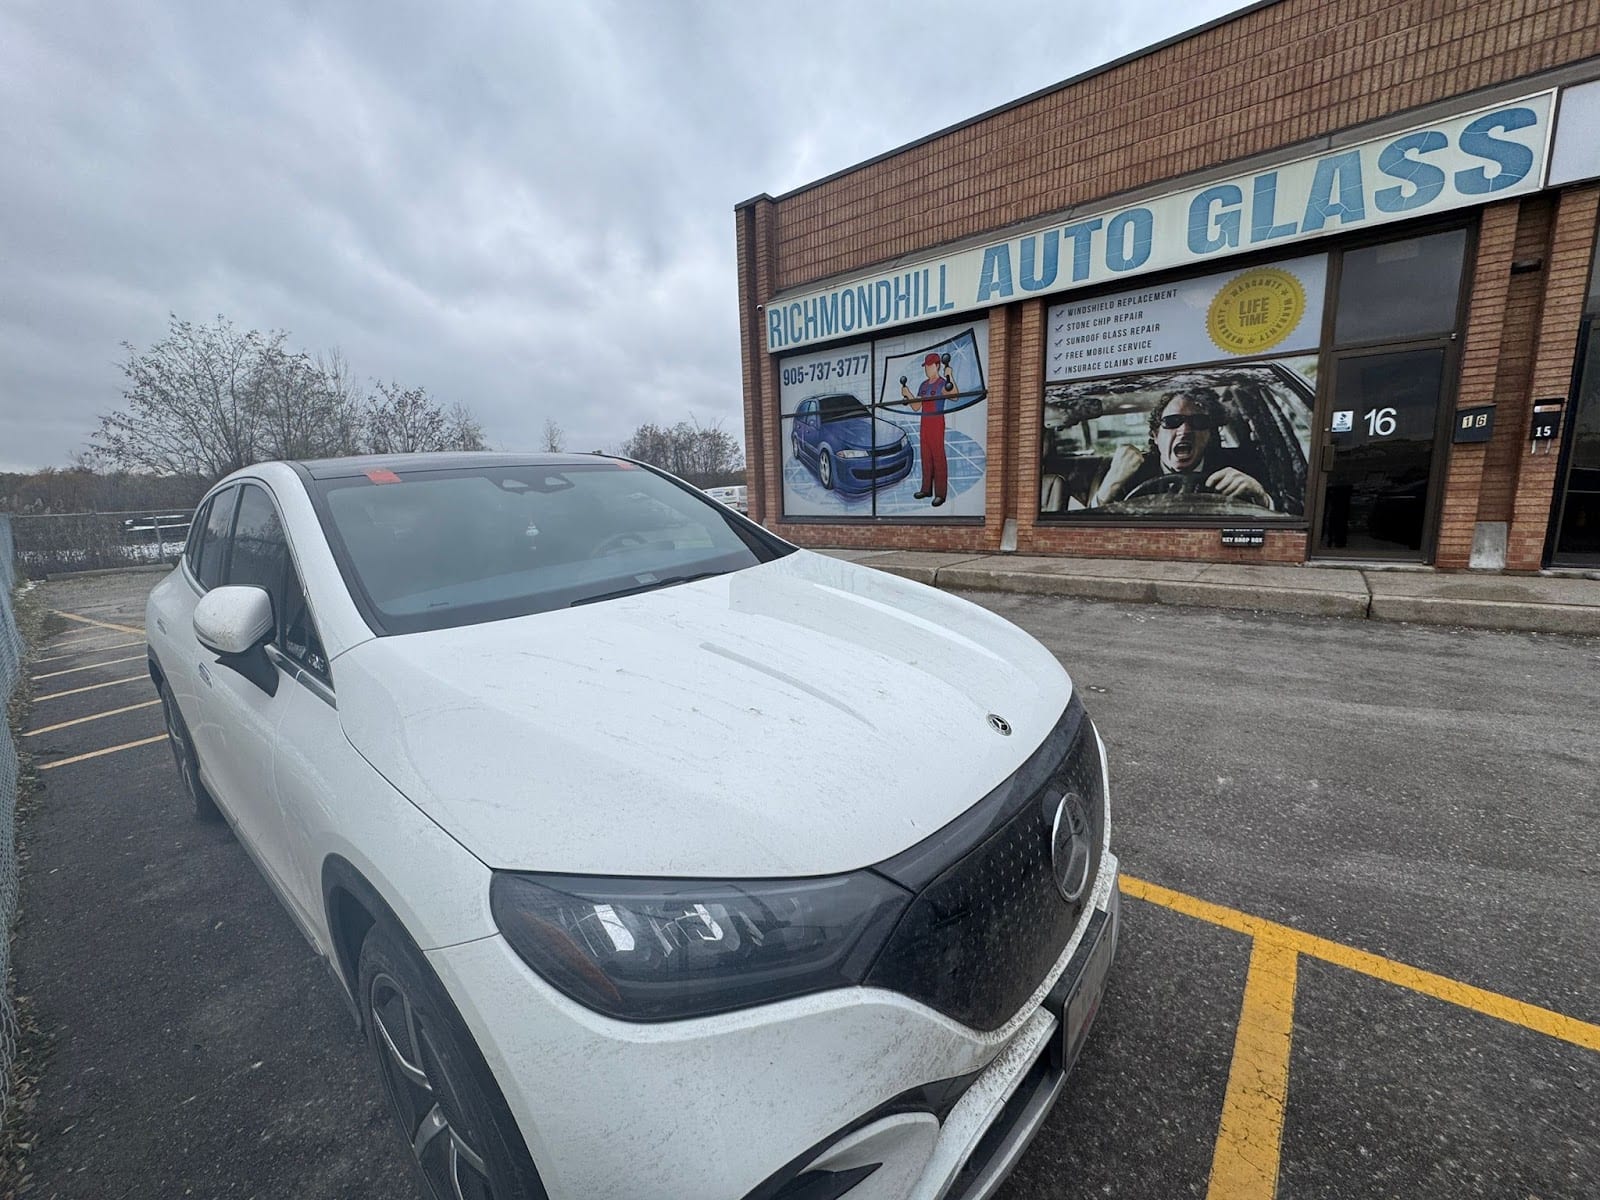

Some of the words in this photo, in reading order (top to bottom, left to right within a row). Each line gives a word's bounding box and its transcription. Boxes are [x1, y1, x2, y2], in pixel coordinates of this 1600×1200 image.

[768, 264, 954, 348] RICHMONDHILL
[976, 207, 1153, 301] AUTO
[1187, 106, 1538, 255] GLASS
[1067, 300, 1115, 317] WINDSHIELD
[1117, 288, 1178, 308] REPLACEMENT
[1239, 297, 1270, 315] LIFE
[1066, 320, 1090, 332] STONE
[1093, 317, 1112, 327] CHIP
[1114, 311, 1144, 323] REPAIR
[1239, 312, 1269, 327] TIME
[1066, 332, 1100, 346] SUNROOF
[1102, 328, 1128, 340] GLASS
[1130, 323, 1161, 336] REPAIR
[1065, 349, 1084, 360] FREE
[1086, 345, 1115, 357] MOBILE
[1117, 340, 1152, 353] SERVICE
[783, 354, 869, 387] 905-737-3777
[1065, 361, 1102, 374] INSURACE
[1104, 357, 1134, 369] CLAIMS
[1137, 351, 1178, 365] WELCOME
[1363, 407, 1398, 436] 16
[1463, 414, 1487, 428] 16
[1535, 425, 1552, 437] 15
